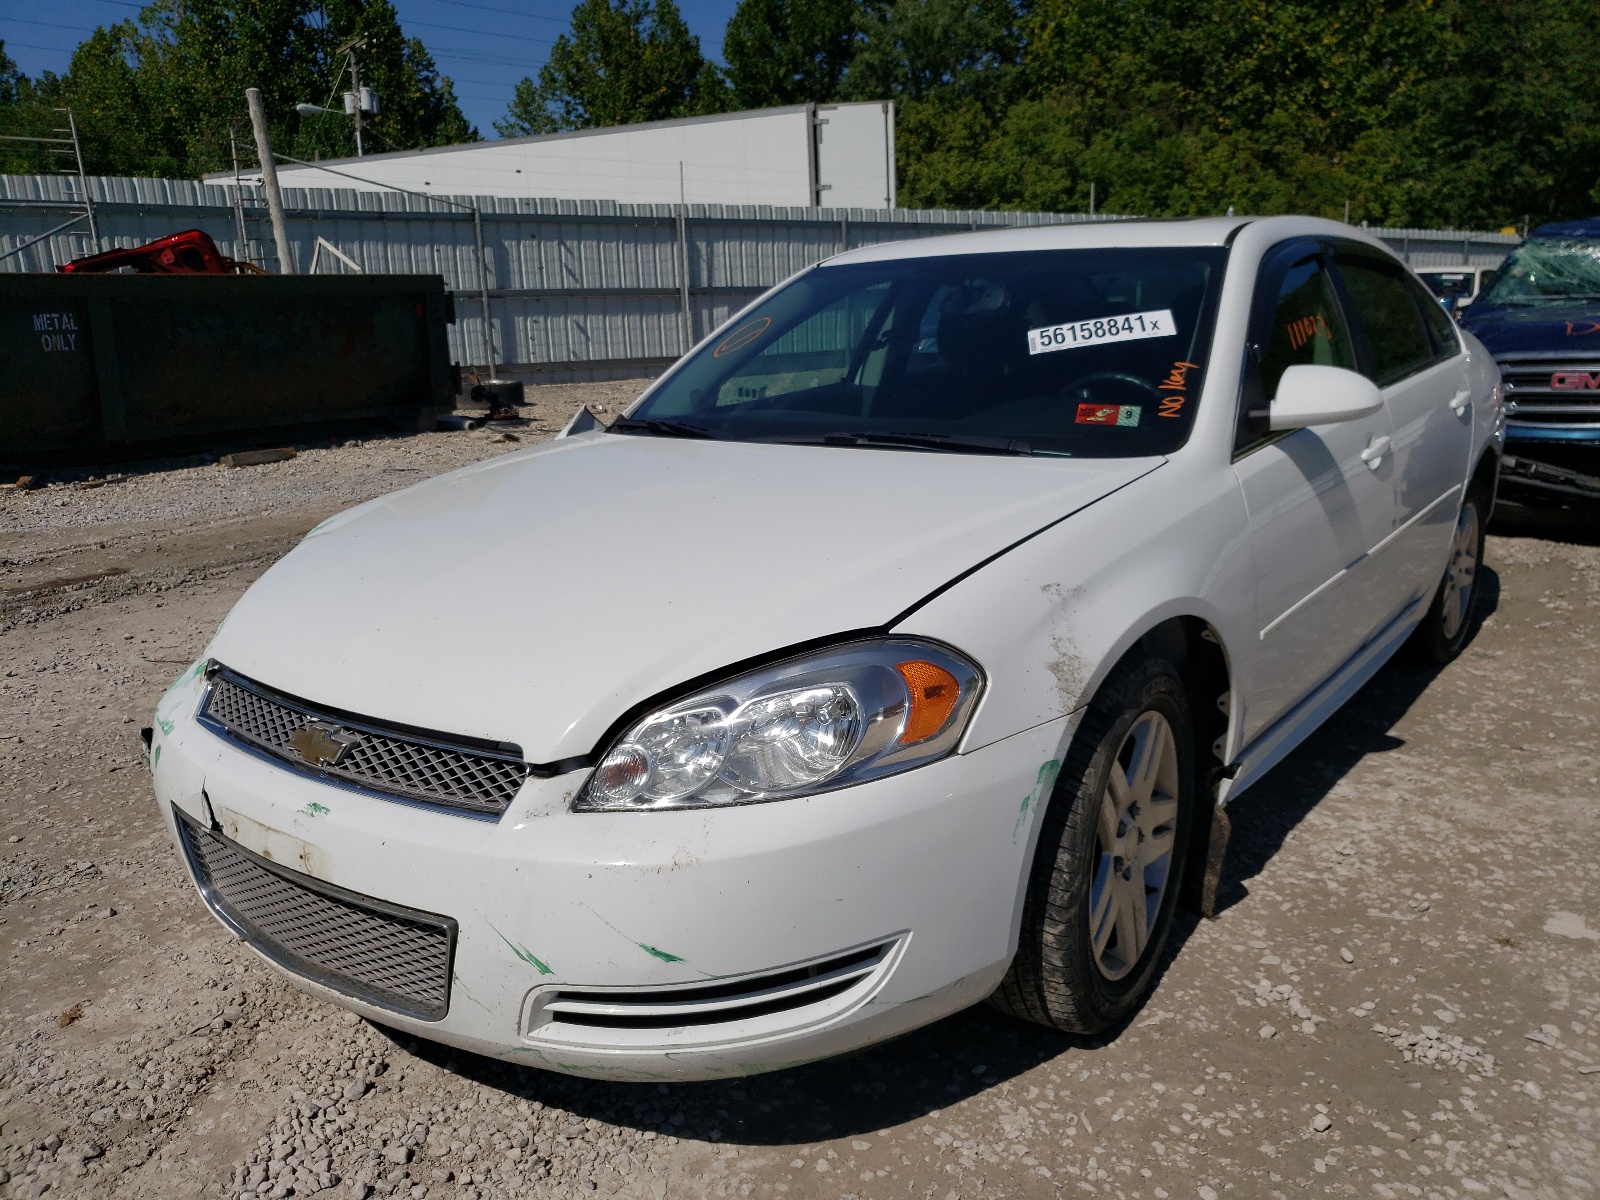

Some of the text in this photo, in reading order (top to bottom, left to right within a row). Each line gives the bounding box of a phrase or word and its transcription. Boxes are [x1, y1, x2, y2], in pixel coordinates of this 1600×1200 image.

[33, 313, 78, 331] METAL
[1040, 315, 1146, 347] 56158841
[42, 333, 75, 352] ONLY
[1078, 407, 1095, 417] 2021
[1125, 410, 1133, 419] 9
